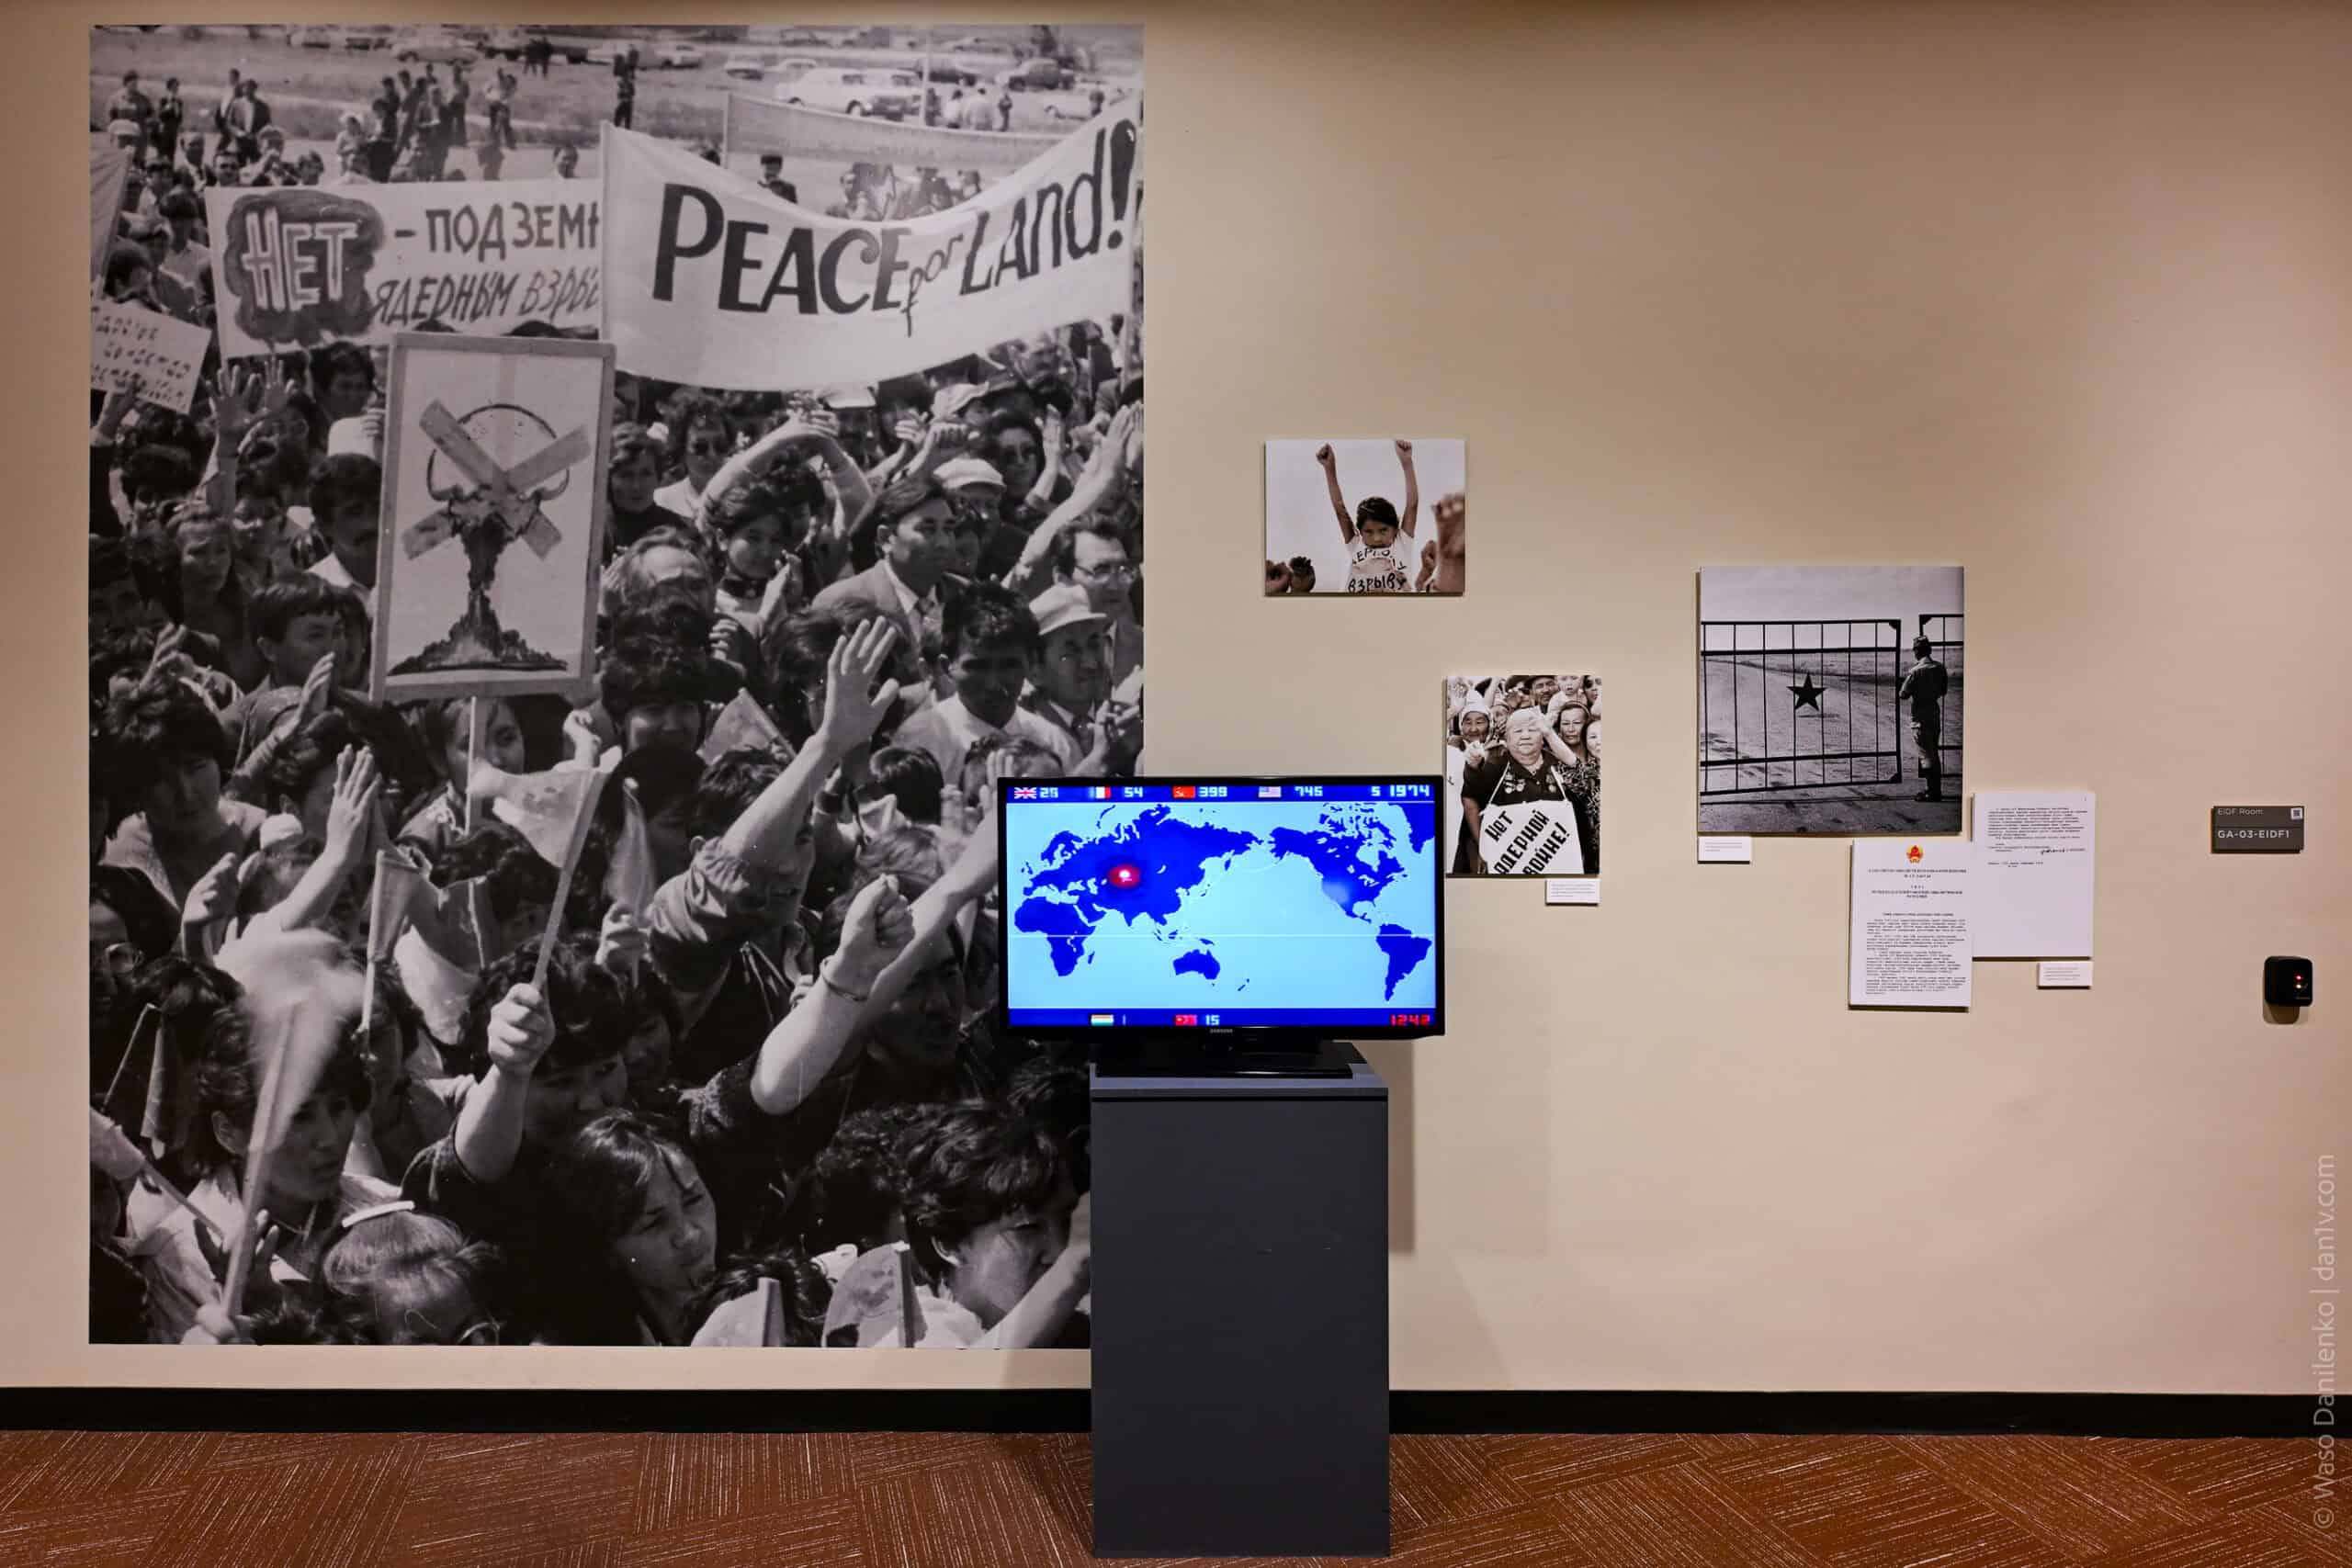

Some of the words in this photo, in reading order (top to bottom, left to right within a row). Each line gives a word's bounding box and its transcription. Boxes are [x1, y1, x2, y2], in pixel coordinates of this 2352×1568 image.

[241, 206, 359, 313] НЕТ
[651, 182, 911, 315] PEACE
[900, 232, 965, 339] for
[371, 270, 522, 327] ЯДЕРНЫМ
[1124, 786, 1144, 798] 54
[1198, 786, 1228, 798] 399
[1294, 786, 1324, 797] 745
[1390, 784, 1430, 797] 1974
[1204, 1013, 1221, 1026] 15
